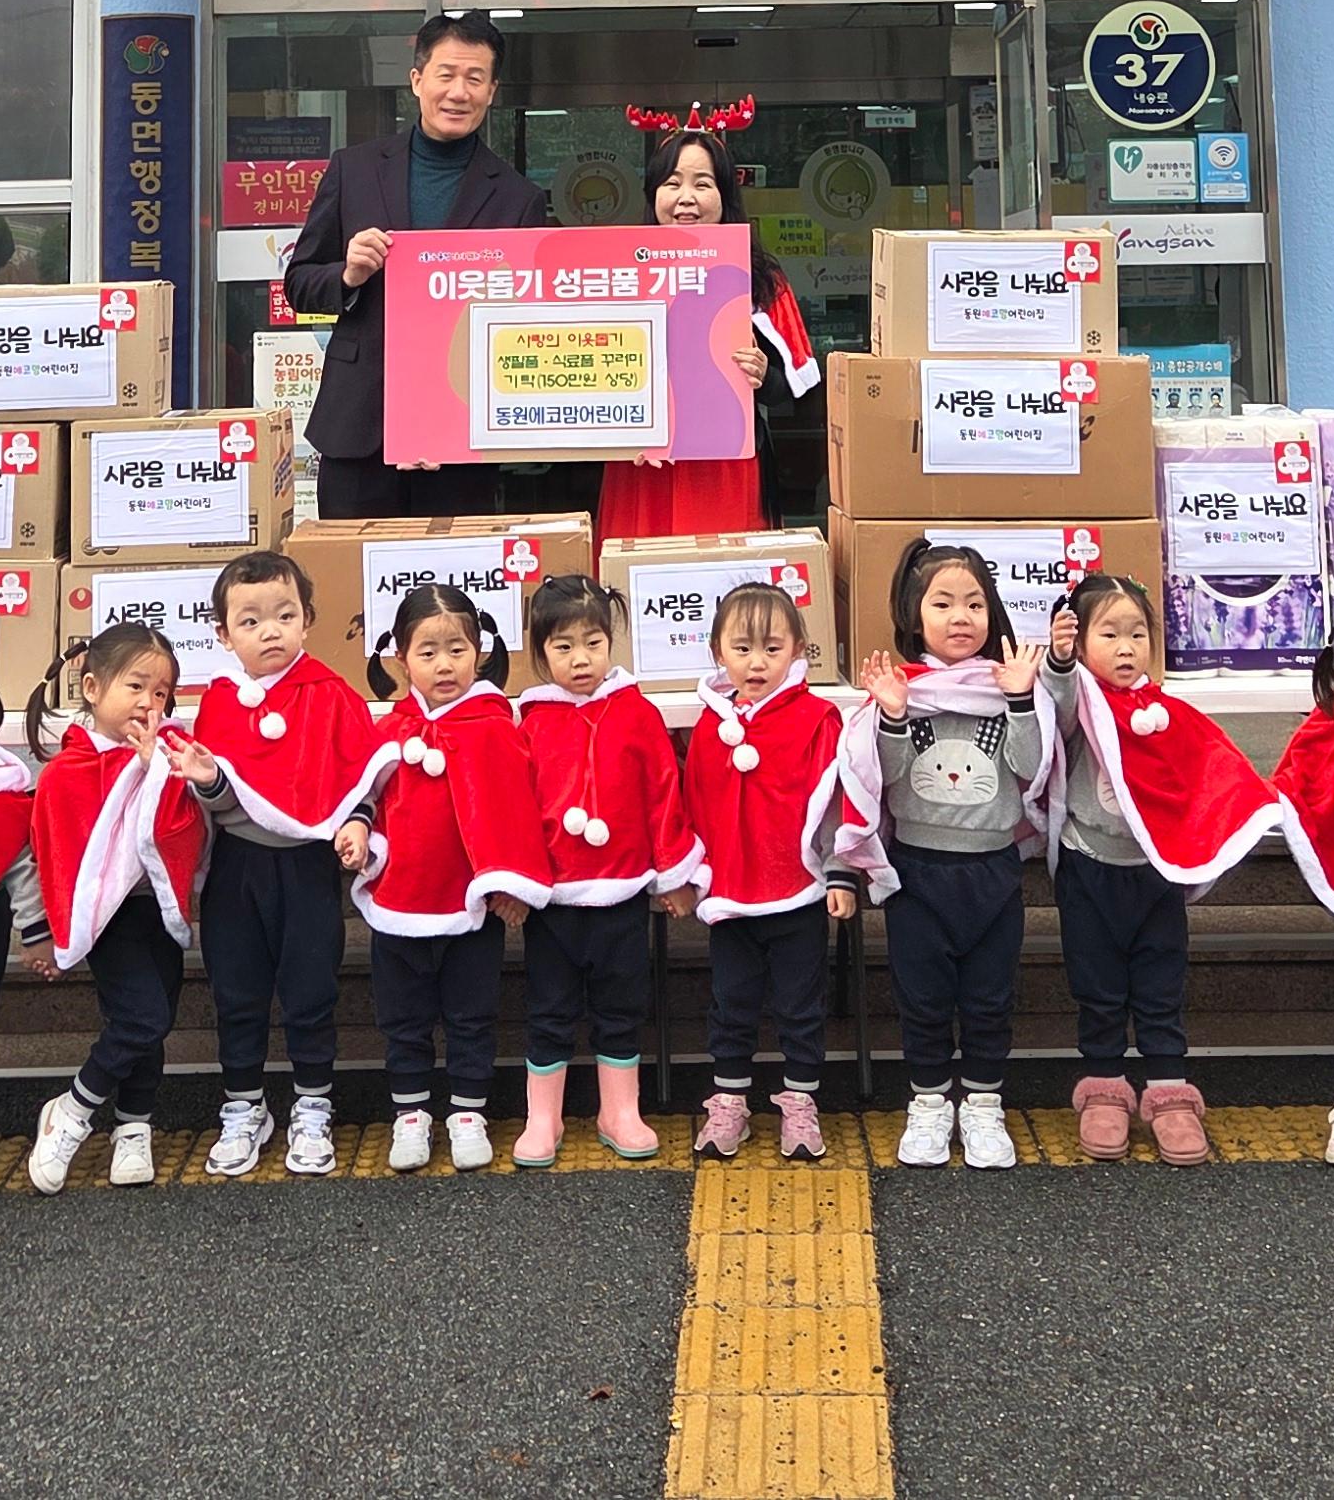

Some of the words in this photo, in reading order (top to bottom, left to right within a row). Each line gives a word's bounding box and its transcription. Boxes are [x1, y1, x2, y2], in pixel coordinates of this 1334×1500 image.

[1114, 53, 1185, 87] 37
[1164, 223, 1215, 236] Active
[428, 269, 543, 300] 이웃돕기
[552, 268, 639, 300] 성금품
[648, 265, 707, 296] 기탁
[940, 270, 1000, 298] 사랑을
[1010, 271, 1069, 295] 나눠요
[43, 325, 105, 349] 나눠요
[517, 333, 560, 348] 사랑의
[275, 353, 314, 367] 2025
[601, 353, 643, 368] 꾸러미
[496, 404, 645, 426] 동원에코맘어린이집
[934, 389, 996, 418] 사랑을
[1006, 391, 1067, 415] 나눠요
[103, 460, 166, 489] 사랑을
[176, 461, 237, 483] 나눠요
[1178, 492, 1240, 521] 사랑을
[1249, 492, 1308, 517] 나눠요
[105, 601, 167, 630] 사랑을
[643, 592, 705, 622] 사랑을
